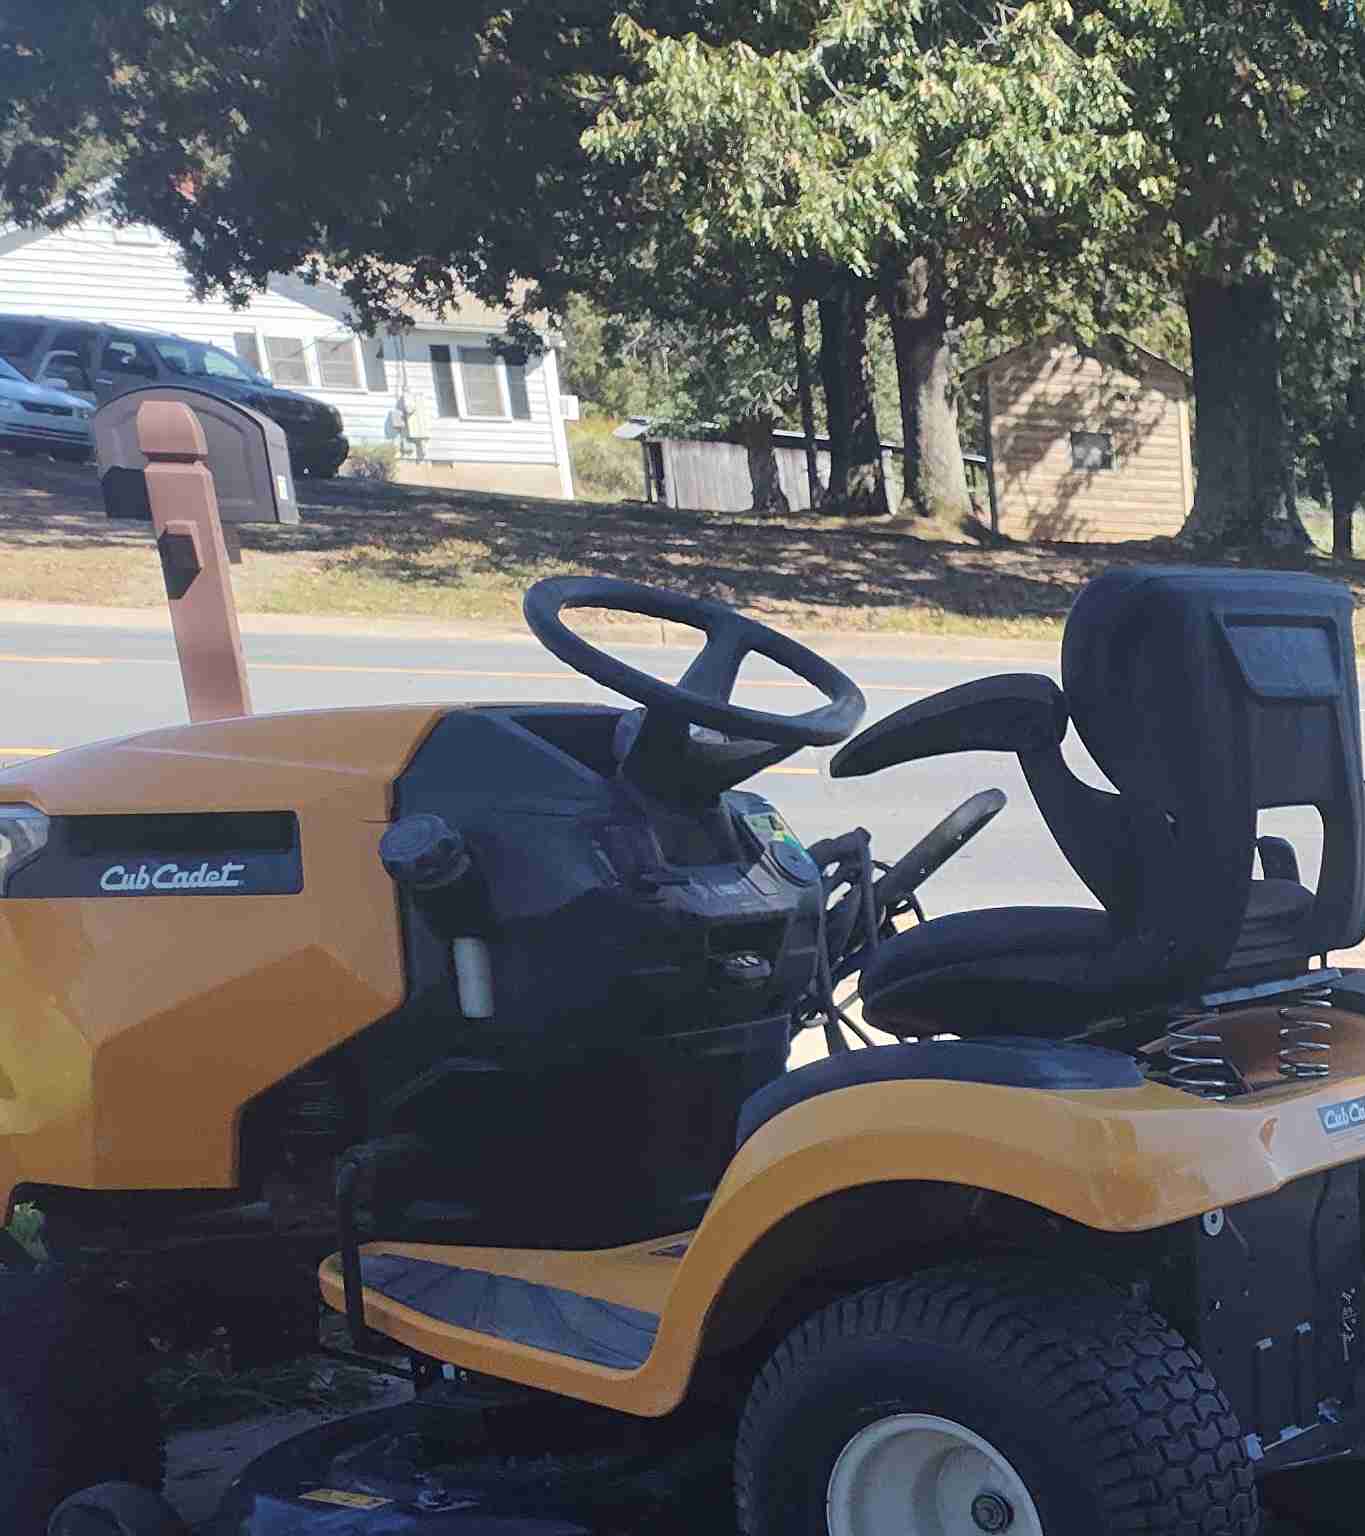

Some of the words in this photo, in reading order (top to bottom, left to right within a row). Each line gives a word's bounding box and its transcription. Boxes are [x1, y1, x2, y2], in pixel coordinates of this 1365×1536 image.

[100, 865, 149, 891] Cub
[151, 862, 245, 889] Cadet
[1324, 1105, 1349, 1129] Cub
